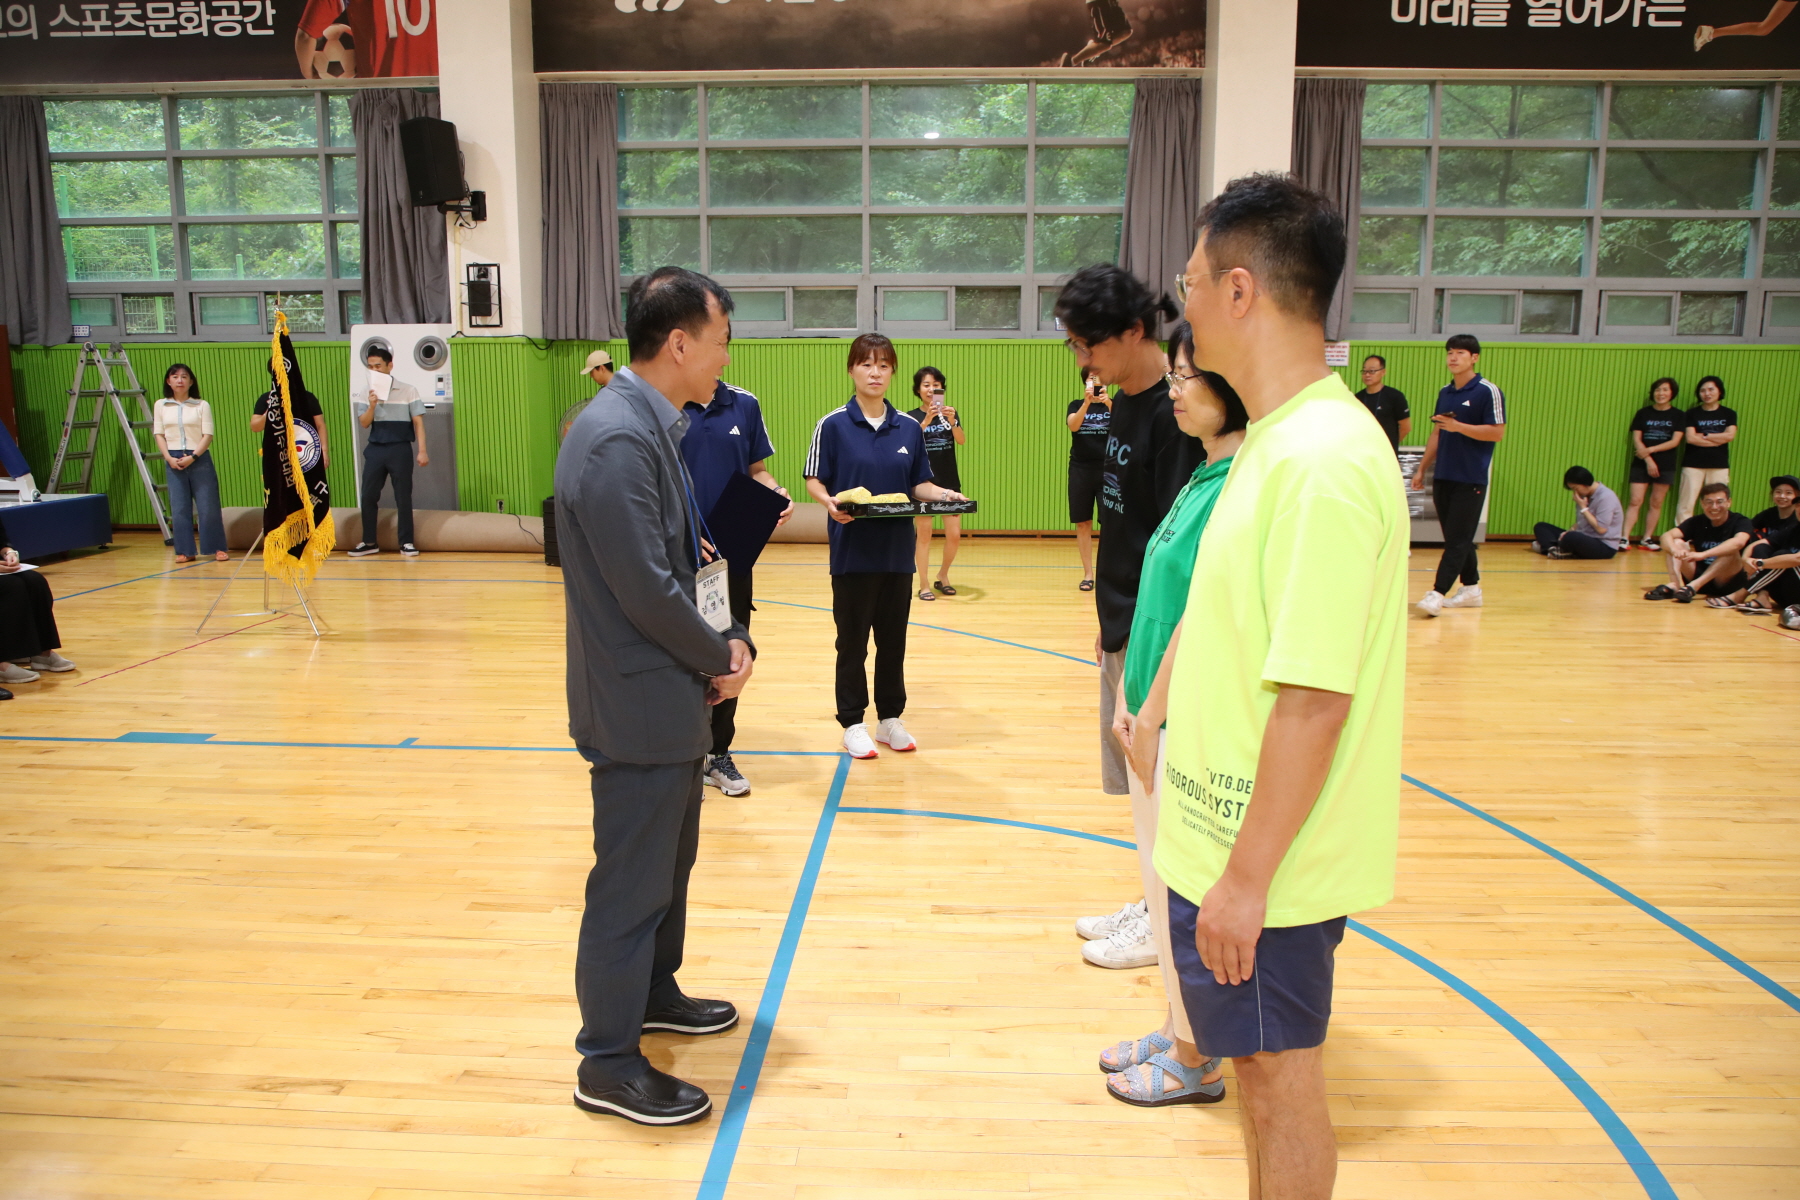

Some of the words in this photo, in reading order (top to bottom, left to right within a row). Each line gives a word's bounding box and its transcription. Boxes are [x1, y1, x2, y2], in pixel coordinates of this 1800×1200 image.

[0, 3, 38, 40] 의
[49, 0, 276, 38] 스포츠문화공간
[385, 0, 430, 38] 10
[702, 575, 720, 589] STAFF
[1166, 761, 1207, 805] RIGOROUS
[1208, 793, 1250, 821] SYST
